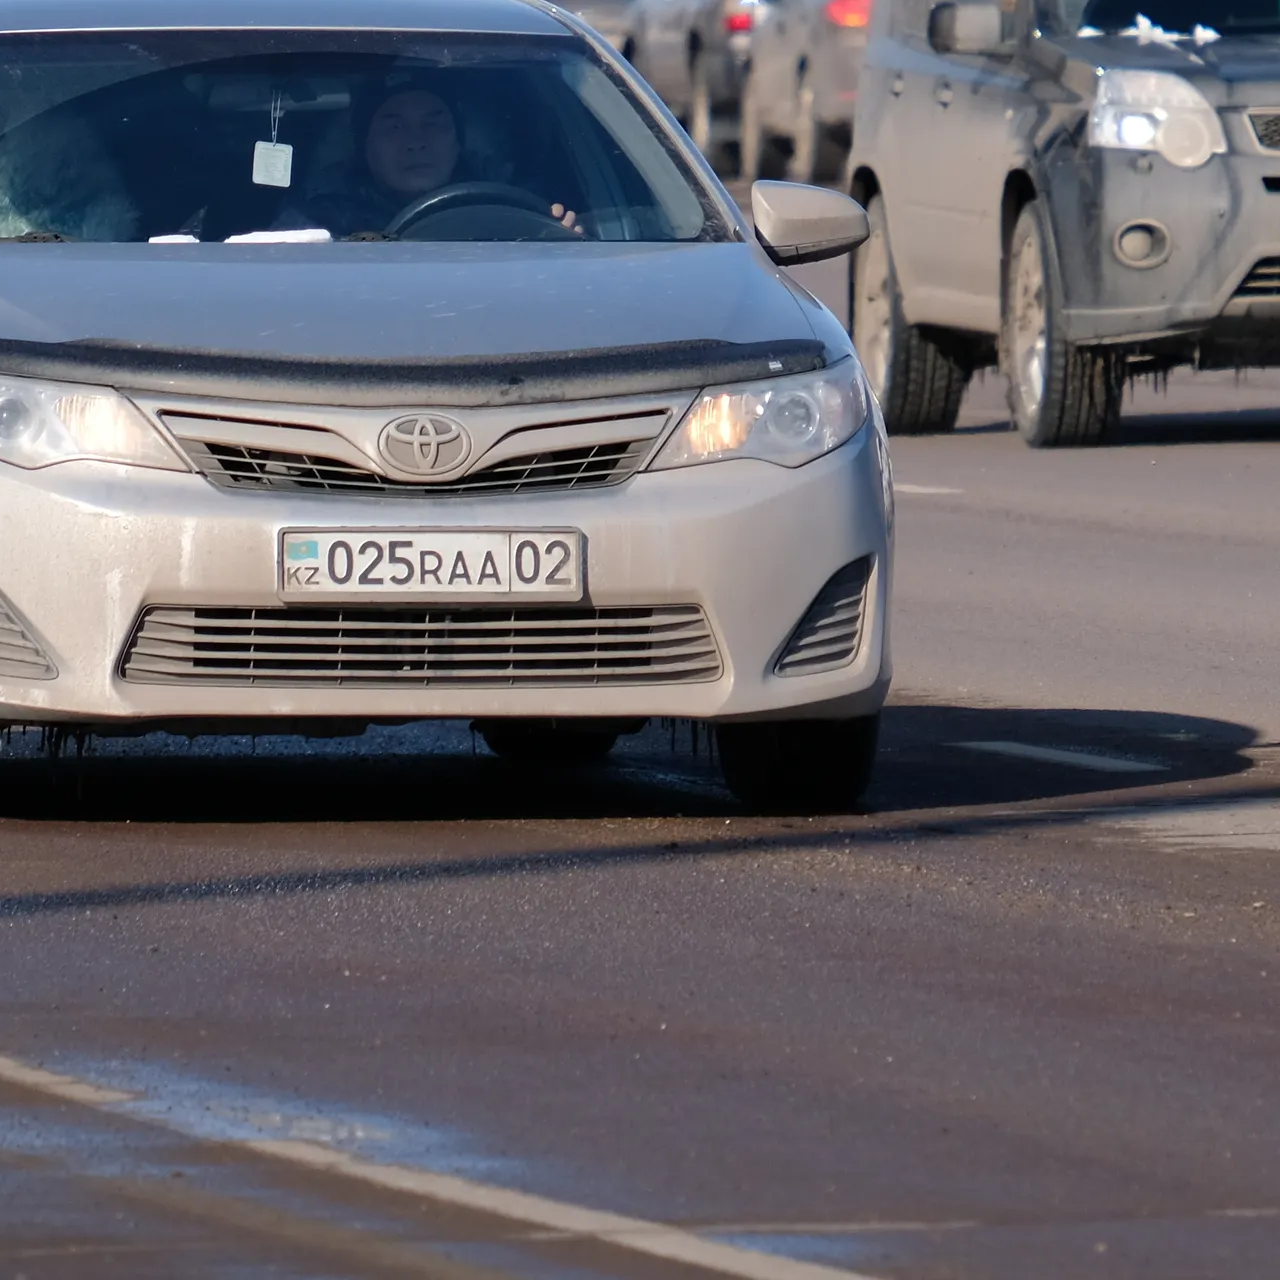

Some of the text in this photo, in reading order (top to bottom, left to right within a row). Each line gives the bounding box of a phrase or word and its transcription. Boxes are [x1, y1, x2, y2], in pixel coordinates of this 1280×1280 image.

[286, 540, 571, 585] KZ 025RAA 02
